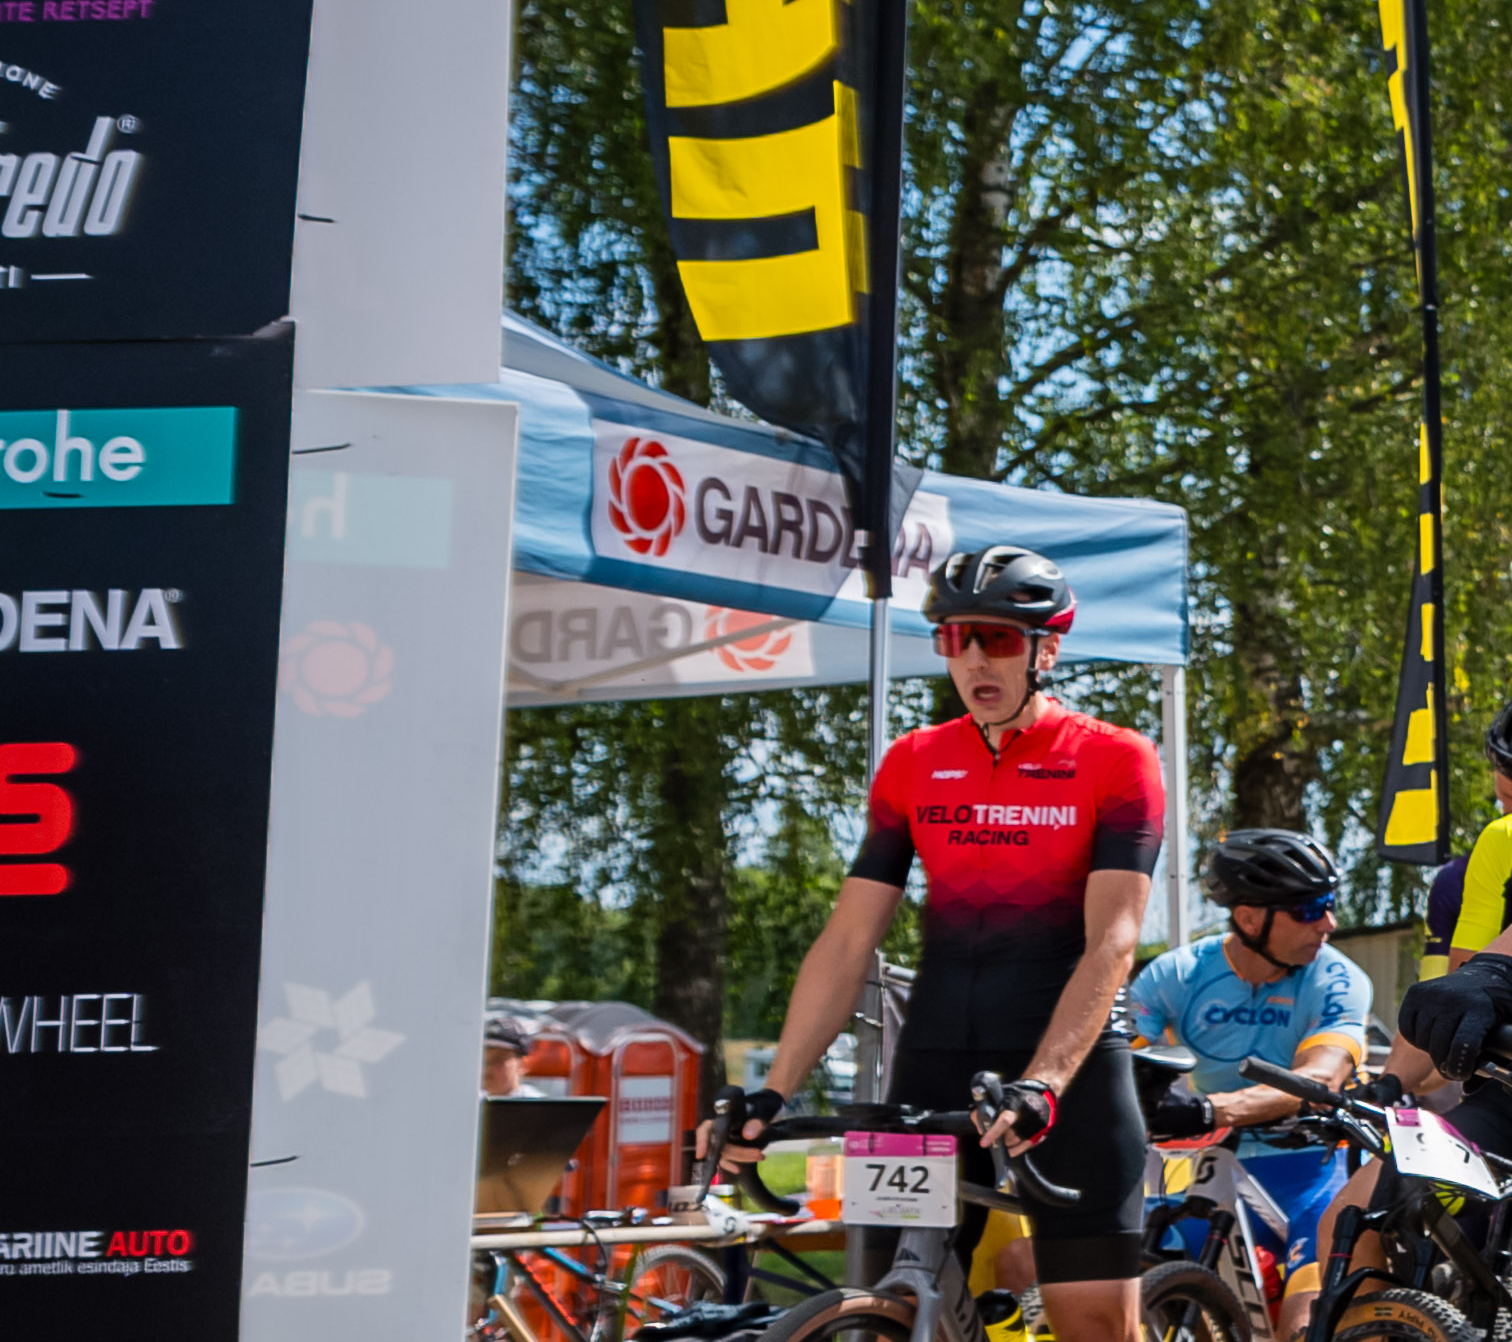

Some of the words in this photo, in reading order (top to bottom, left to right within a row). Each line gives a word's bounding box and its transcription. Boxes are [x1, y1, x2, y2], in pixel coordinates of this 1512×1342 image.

[0, 62, 62, 100] ONE
[0, 408, 146, 483] ohe
[948, 830, 1031, 846] RACING
[1204, 1007, 1292, 1029] CYCLON
[866, 1163, 930, 1194] 742
[106, 1230, 191, 1257] AUTO
[19, 1260, 73, 1276] ametlik
[143, 1256, 191, 1275] Eestis
